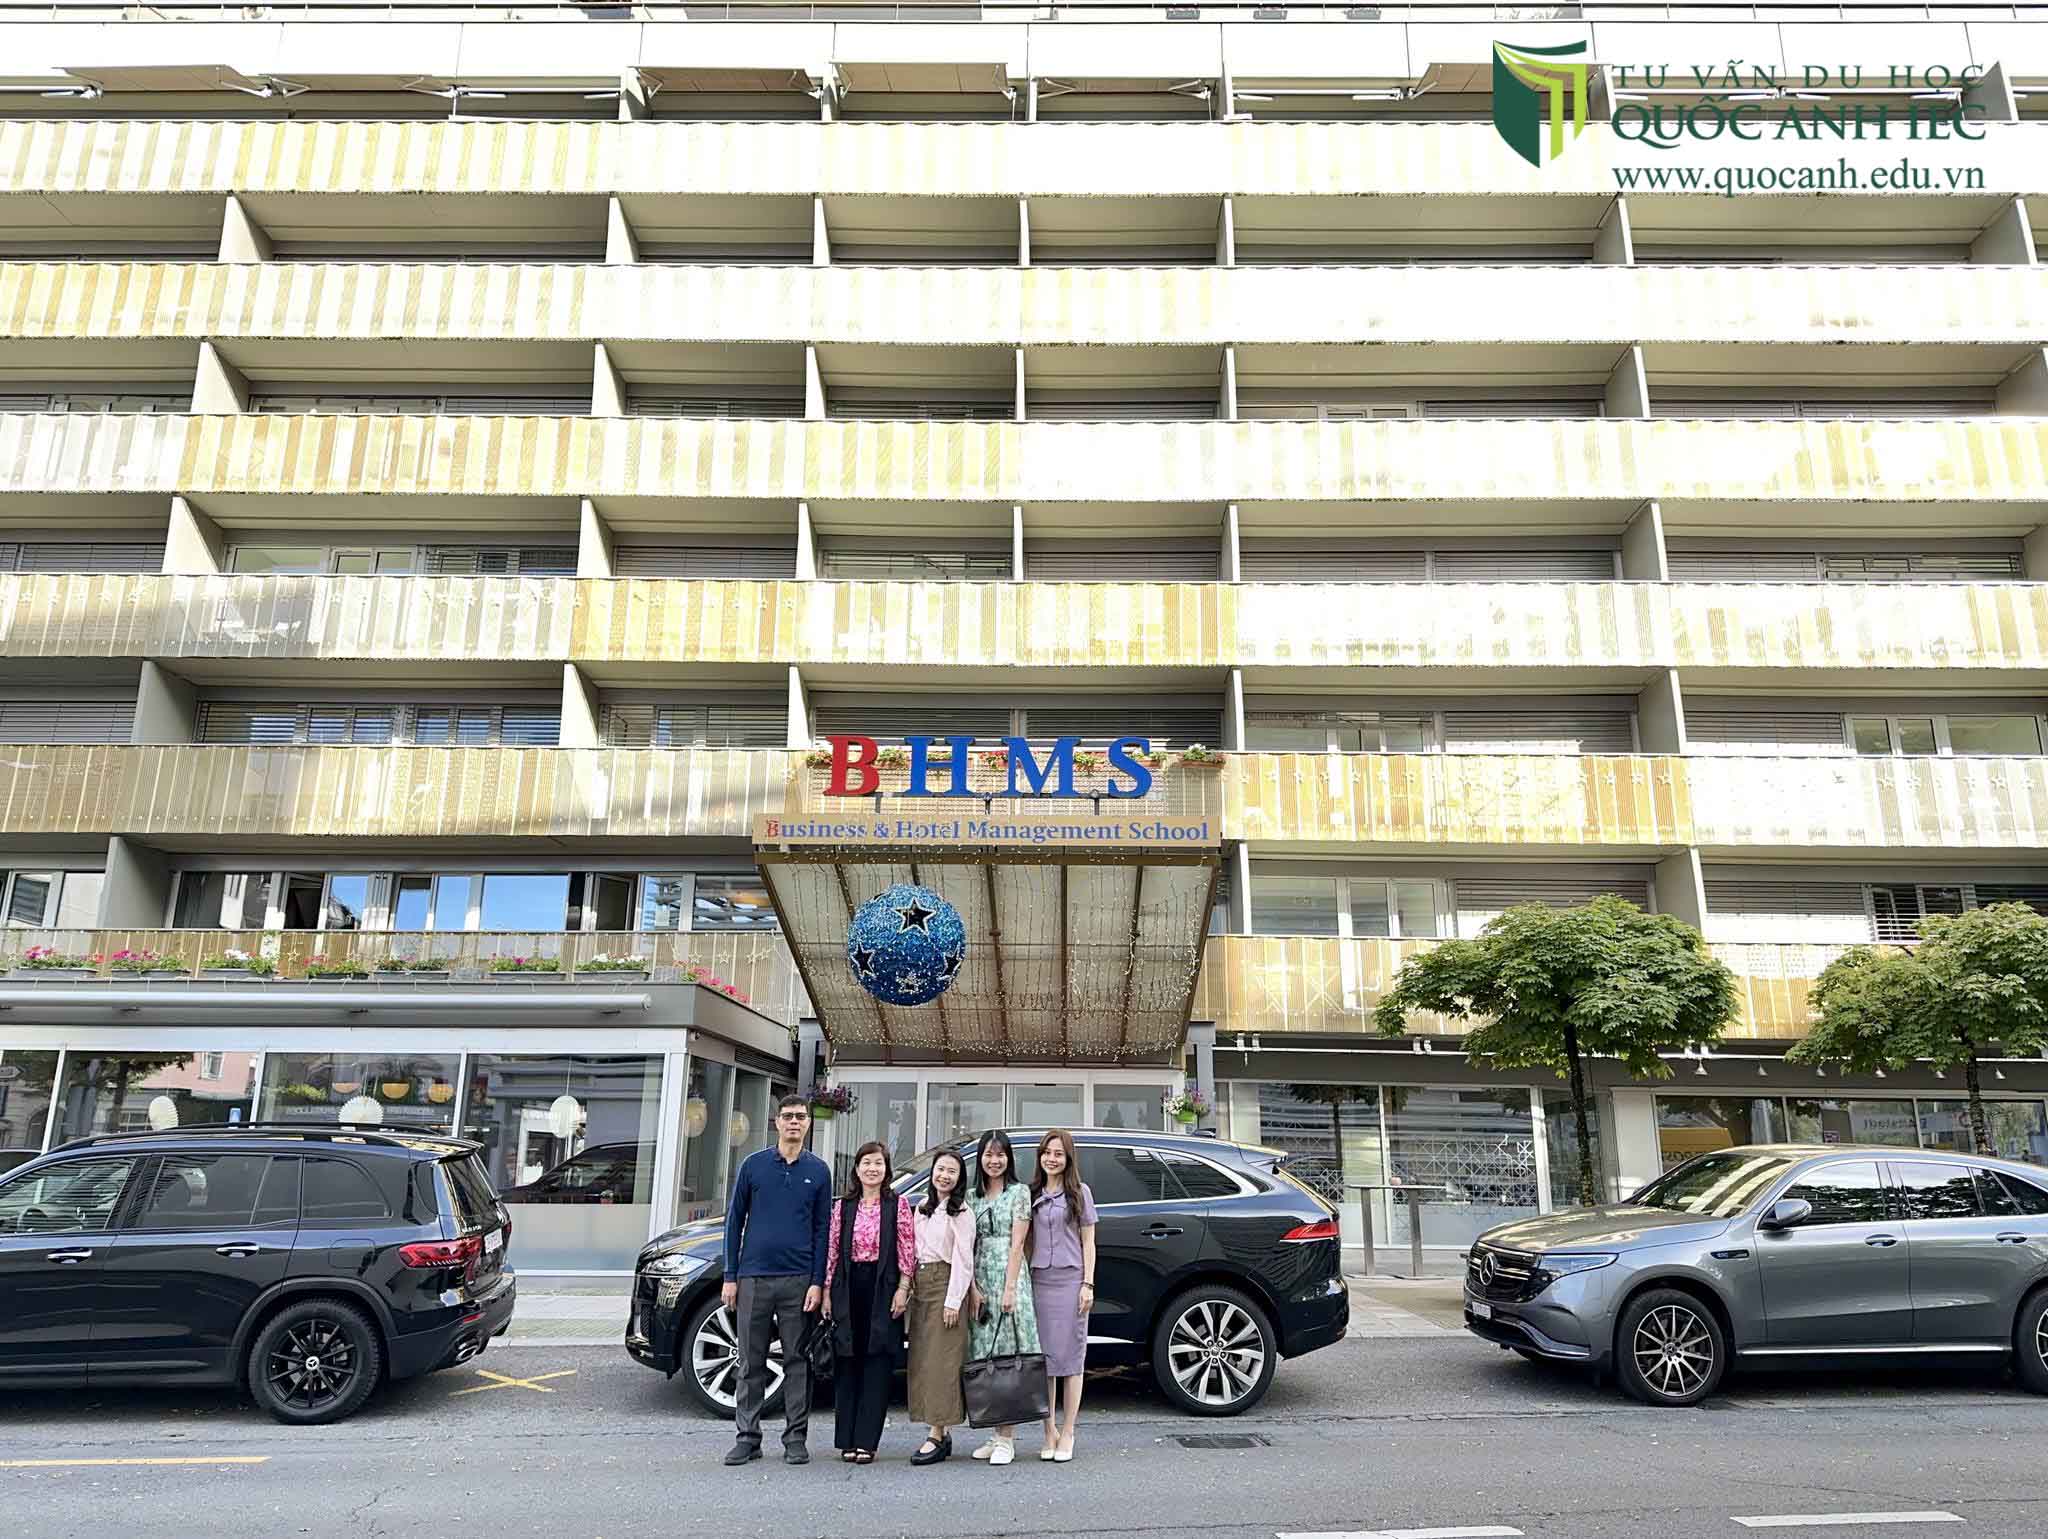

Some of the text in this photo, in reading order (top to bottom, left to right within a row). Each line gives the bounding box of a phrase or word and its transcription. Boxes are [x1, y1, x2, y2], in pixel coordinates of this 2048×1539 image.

[822, 735, 1153, 798] BHMS
[766, 820, 1208, 844] Business & Hotel Management School
